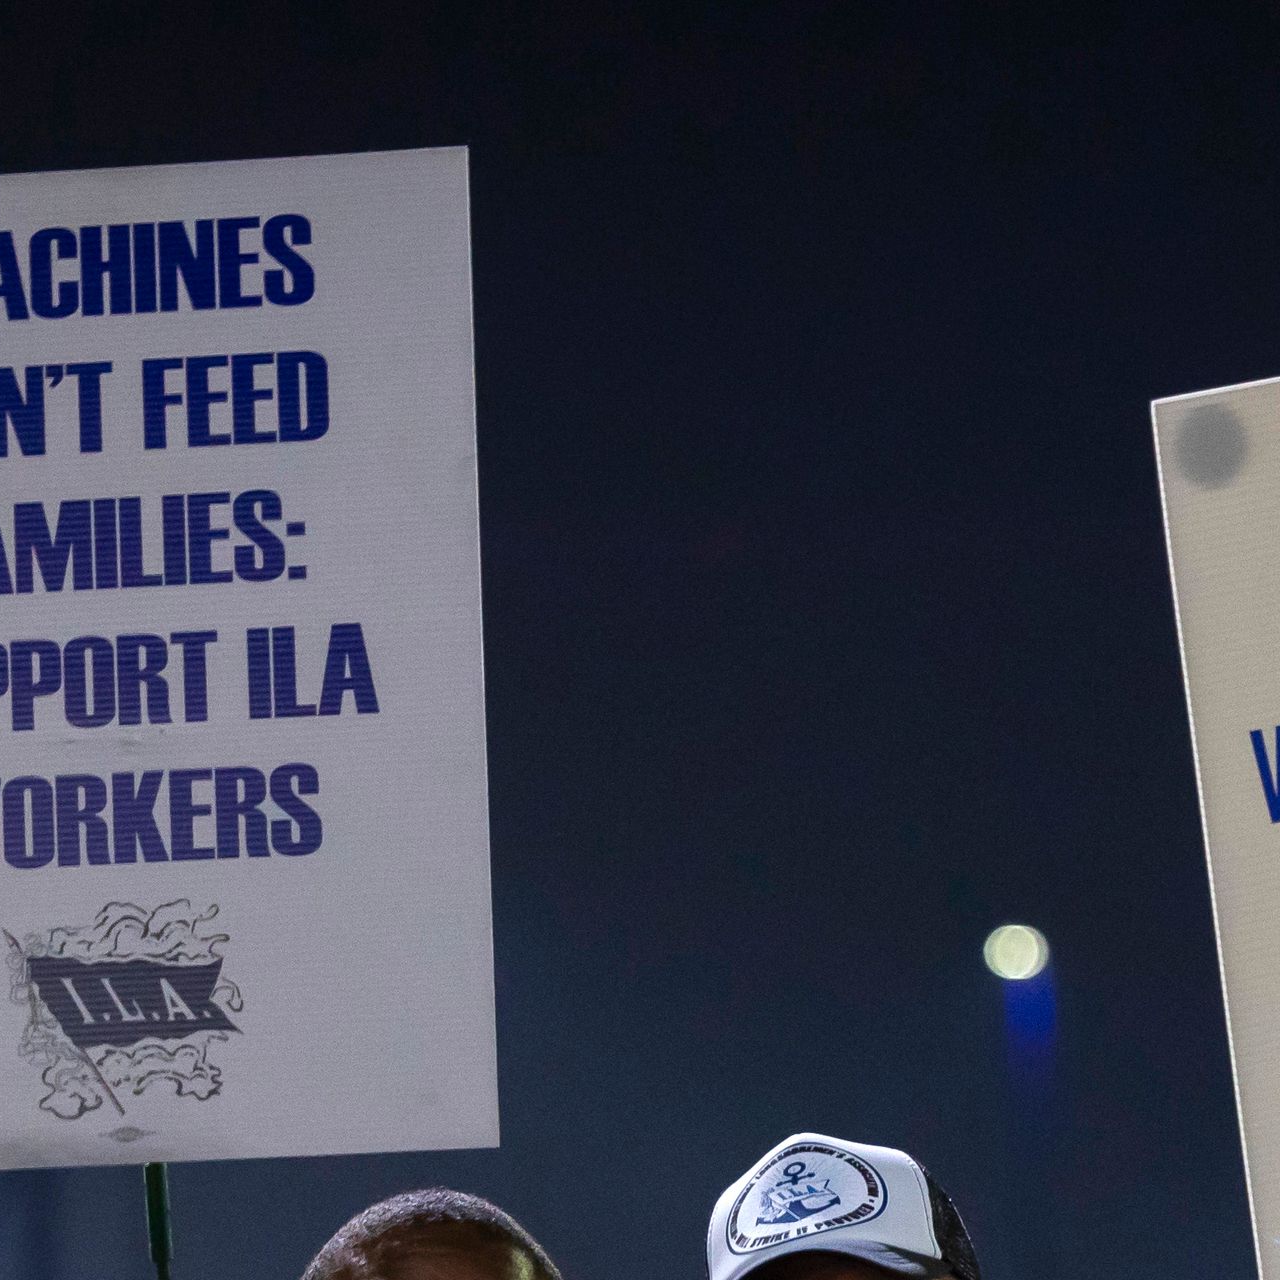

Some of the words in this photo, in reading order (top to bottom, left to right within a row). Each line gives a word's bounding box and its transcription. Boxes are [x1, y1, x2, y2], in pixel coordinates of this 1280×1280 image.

[142, 350, 330, 450] FEED
[246, 622, 380, 720] ILA
[60, 977, 213, 1024] I.L.A.
